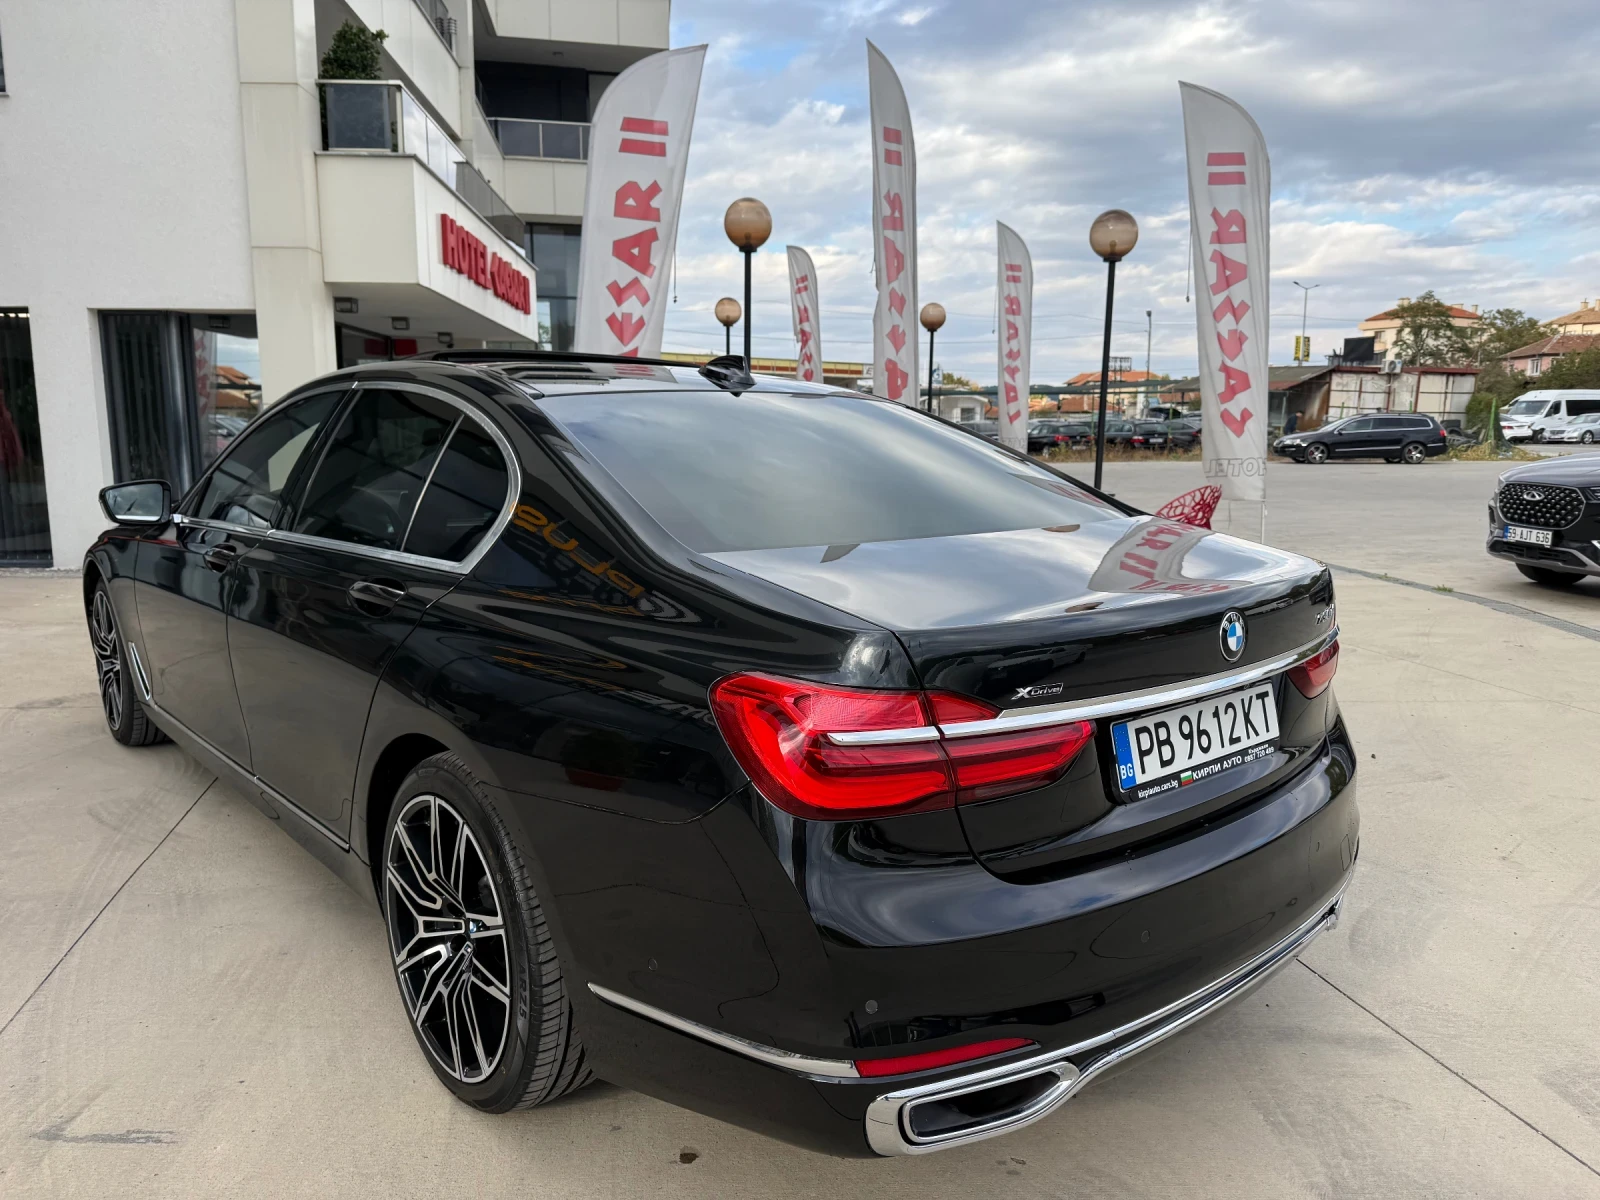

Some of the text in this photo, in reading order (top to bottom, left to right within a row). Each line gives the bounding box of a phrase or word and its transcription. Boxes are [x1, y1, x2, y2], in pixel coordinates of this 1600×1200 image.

[440, 213, 492, 290] HOTEL
[1520, 530, 1533, 541] AJT
[1536, 531, 1550, 543] 636
[1120, 762, 1134, 780] BG
[1192, 755, 1242, 781] КИРПИ АУТО
